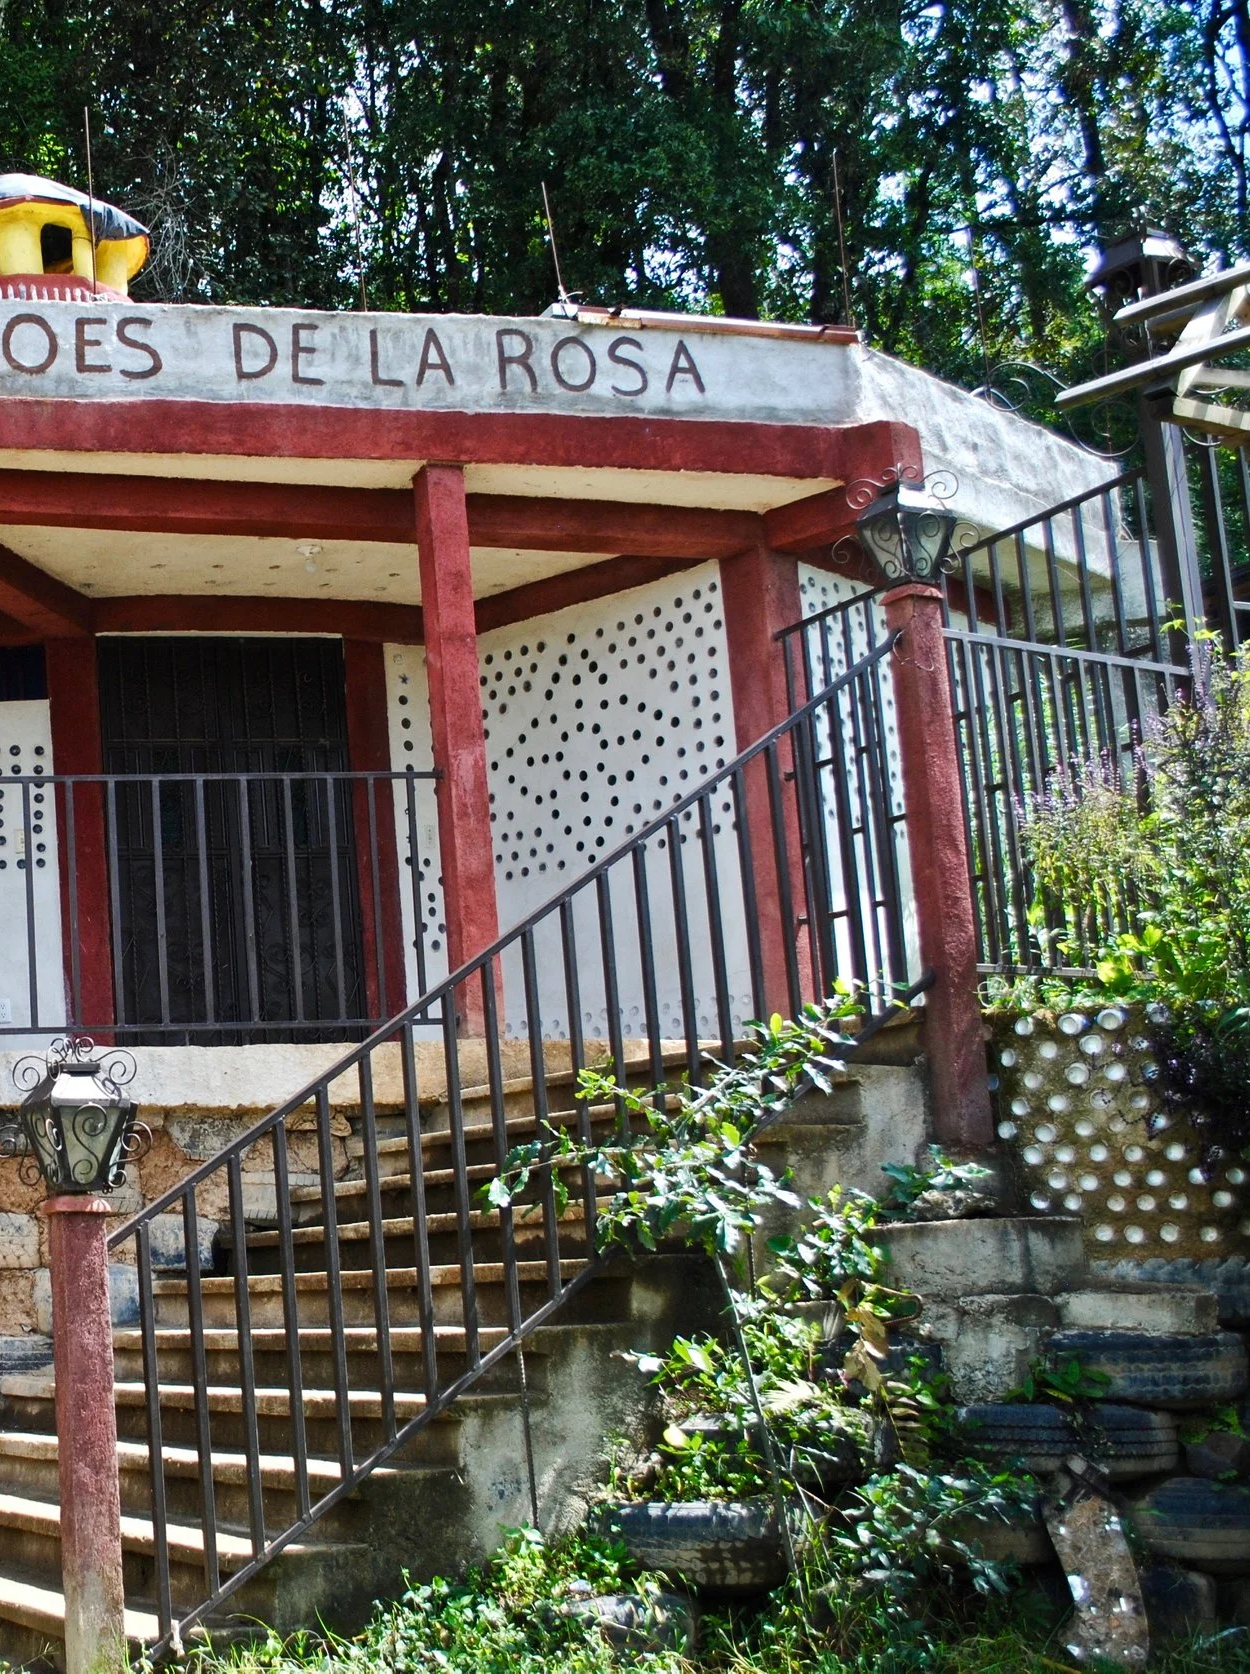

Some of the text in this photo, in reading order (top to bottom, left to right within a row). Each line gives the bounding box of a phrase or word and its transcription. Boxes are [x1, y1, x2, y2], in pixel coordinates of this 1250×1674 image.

[232, 322, 325, 386] DE
[369, 327, 455, 388] LA
[495, 327, 707, 397] ROSA
